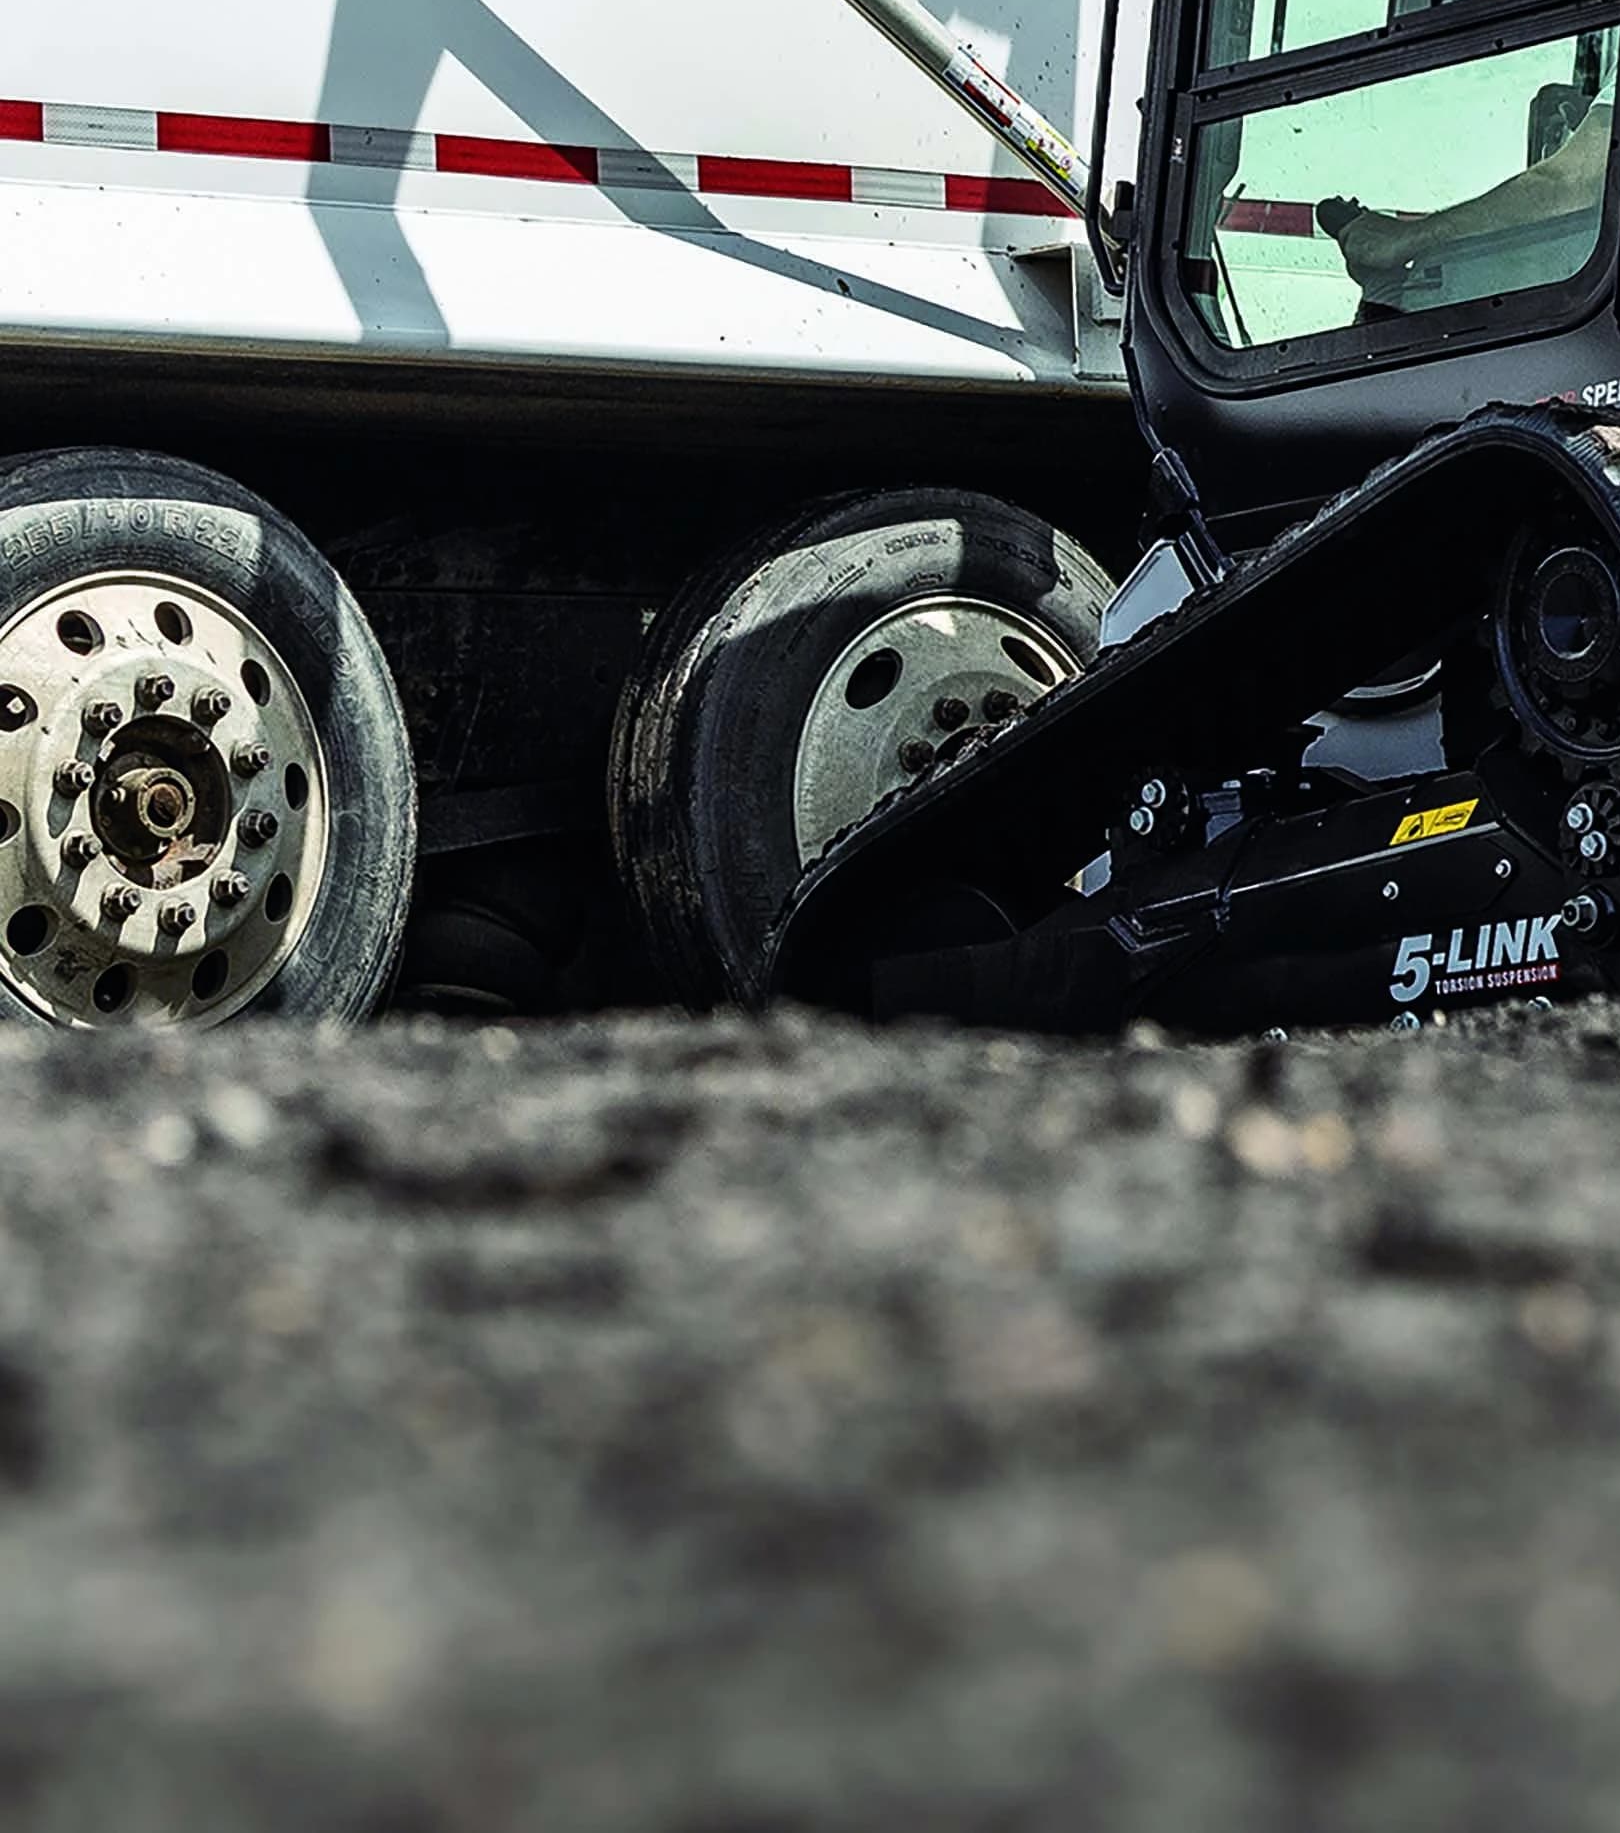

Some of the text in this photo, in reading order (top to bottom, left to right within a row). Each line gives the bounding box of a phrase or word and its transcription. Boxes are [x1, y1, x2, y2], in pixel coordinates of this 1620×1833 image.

[1389, 913, 1563, 1002] 5-LINK
[1434, 964, 1558, 995] TORSION SUSPENSION
